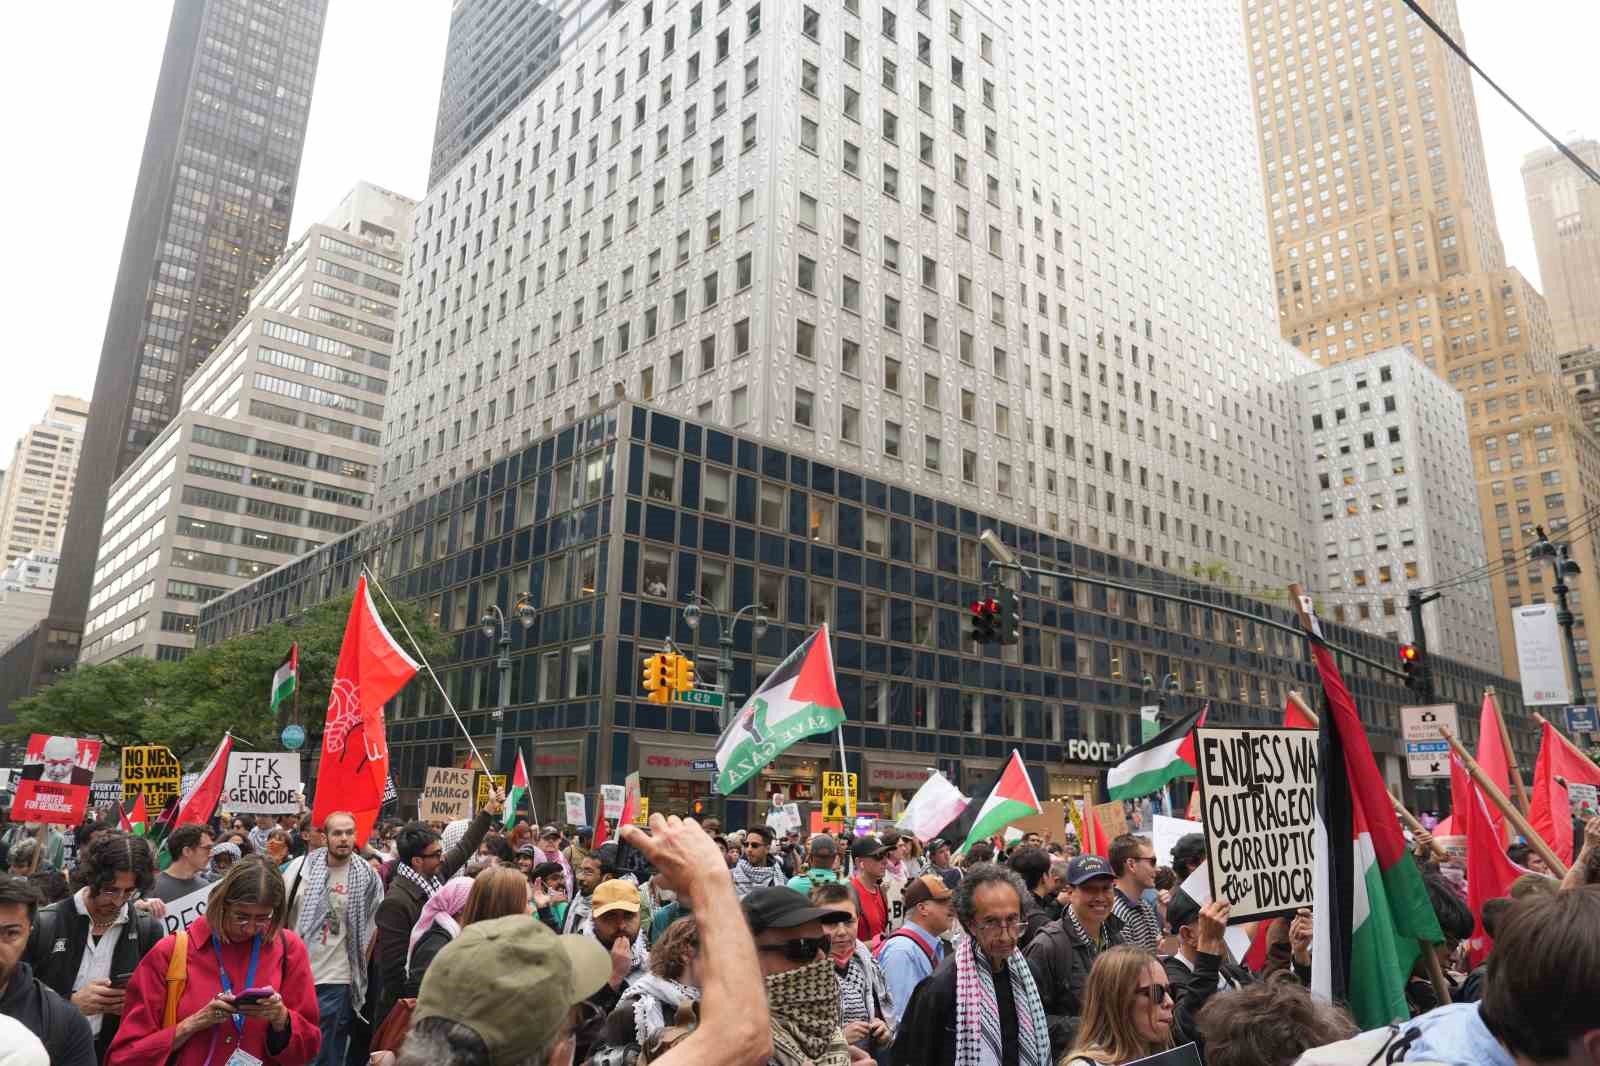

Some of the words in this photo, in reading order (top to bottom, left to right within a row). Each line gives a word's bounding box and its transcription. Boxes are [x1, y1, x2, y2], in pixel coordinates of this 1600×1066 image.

[693, 692, 702, 702] 42
[125, 749, 144, 766] NO
[147, 749, 177, 766] NEW
[1068, 739, 1110, 761] FOOT
[240, 758, 280, 775] JFK
[1285, 737, 1320, 784] WA
[125, 767, 144, 779] US
[146, 767, 177, 778] WAR
[433, 770, 469, 785] ARMS
[125, 783, 142, 793] IN
[144, 783, 177, 793] THE
[239, 775, 281, 789] FLIES
[229, 788, 296, 804] GENOCIDE
[425, 786, 469, 799] EMBARGO
[431, 801, 461, 815] NOW!
[1221, 873, 1252, 905] the
[1253, 868, 1313, 908] IDIOCR
